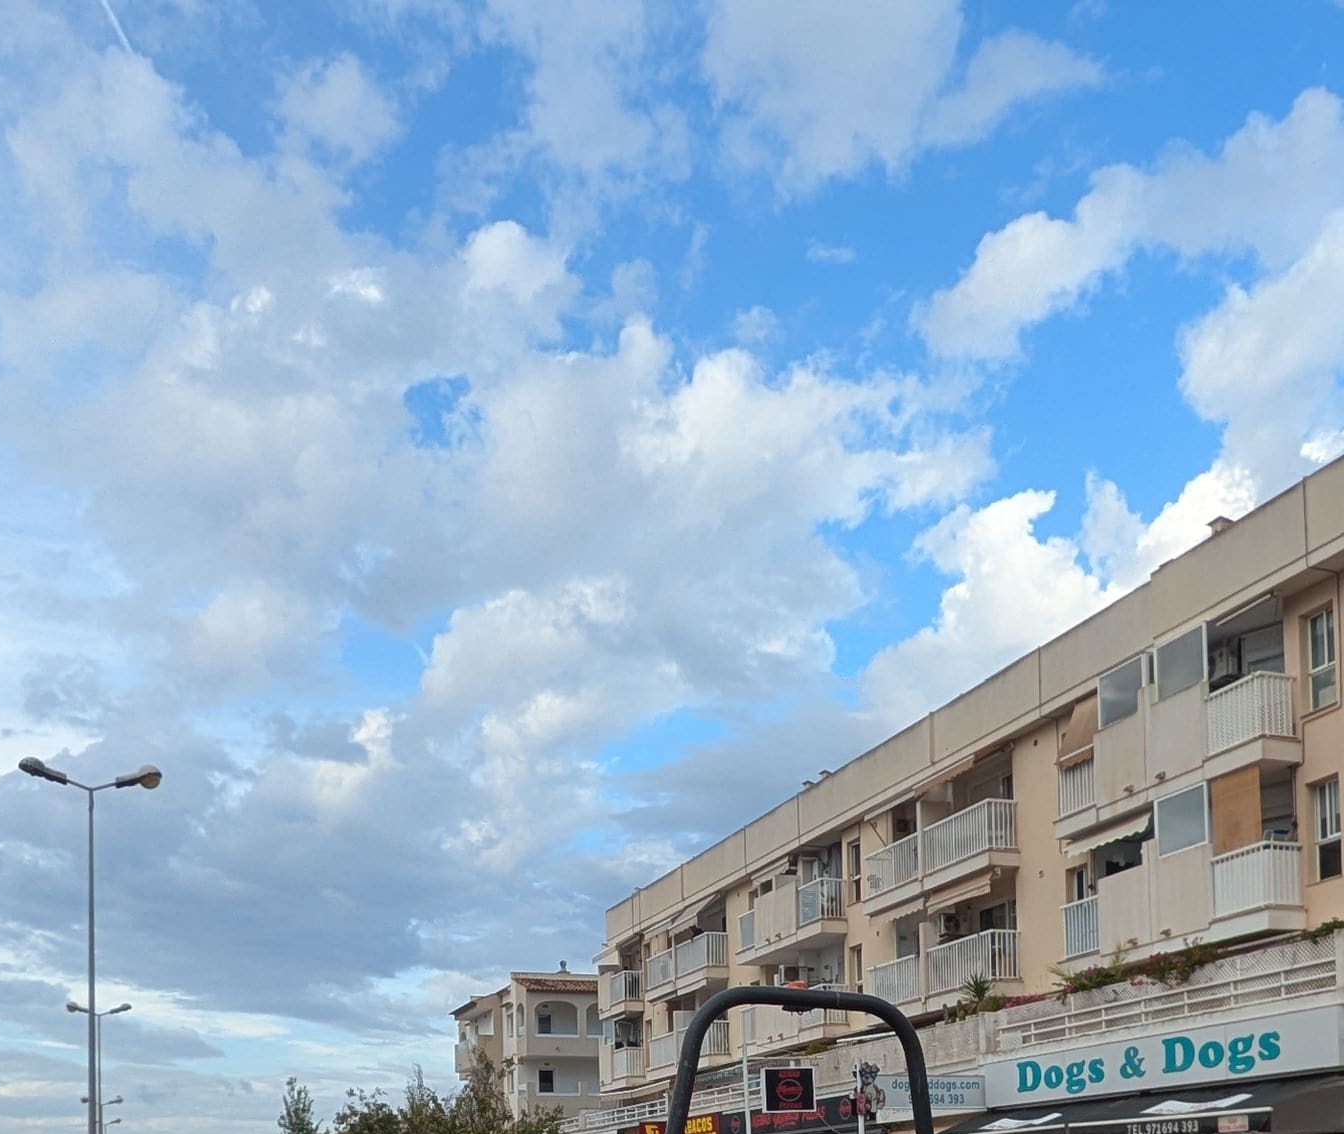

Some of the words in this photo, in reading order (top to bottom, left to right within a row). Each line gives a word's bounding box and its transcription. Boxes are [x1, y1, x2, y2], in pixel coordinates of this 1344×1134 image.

[1016, 1056, 1105, 1094] Dogs
[1119, 1046, 1146, 1079] &
[1162, 1031, 1281, 1075] Dogs
[891, 1078, 981, 1092] dogddogs.com
[948, 1093, 965, 1104] 393
